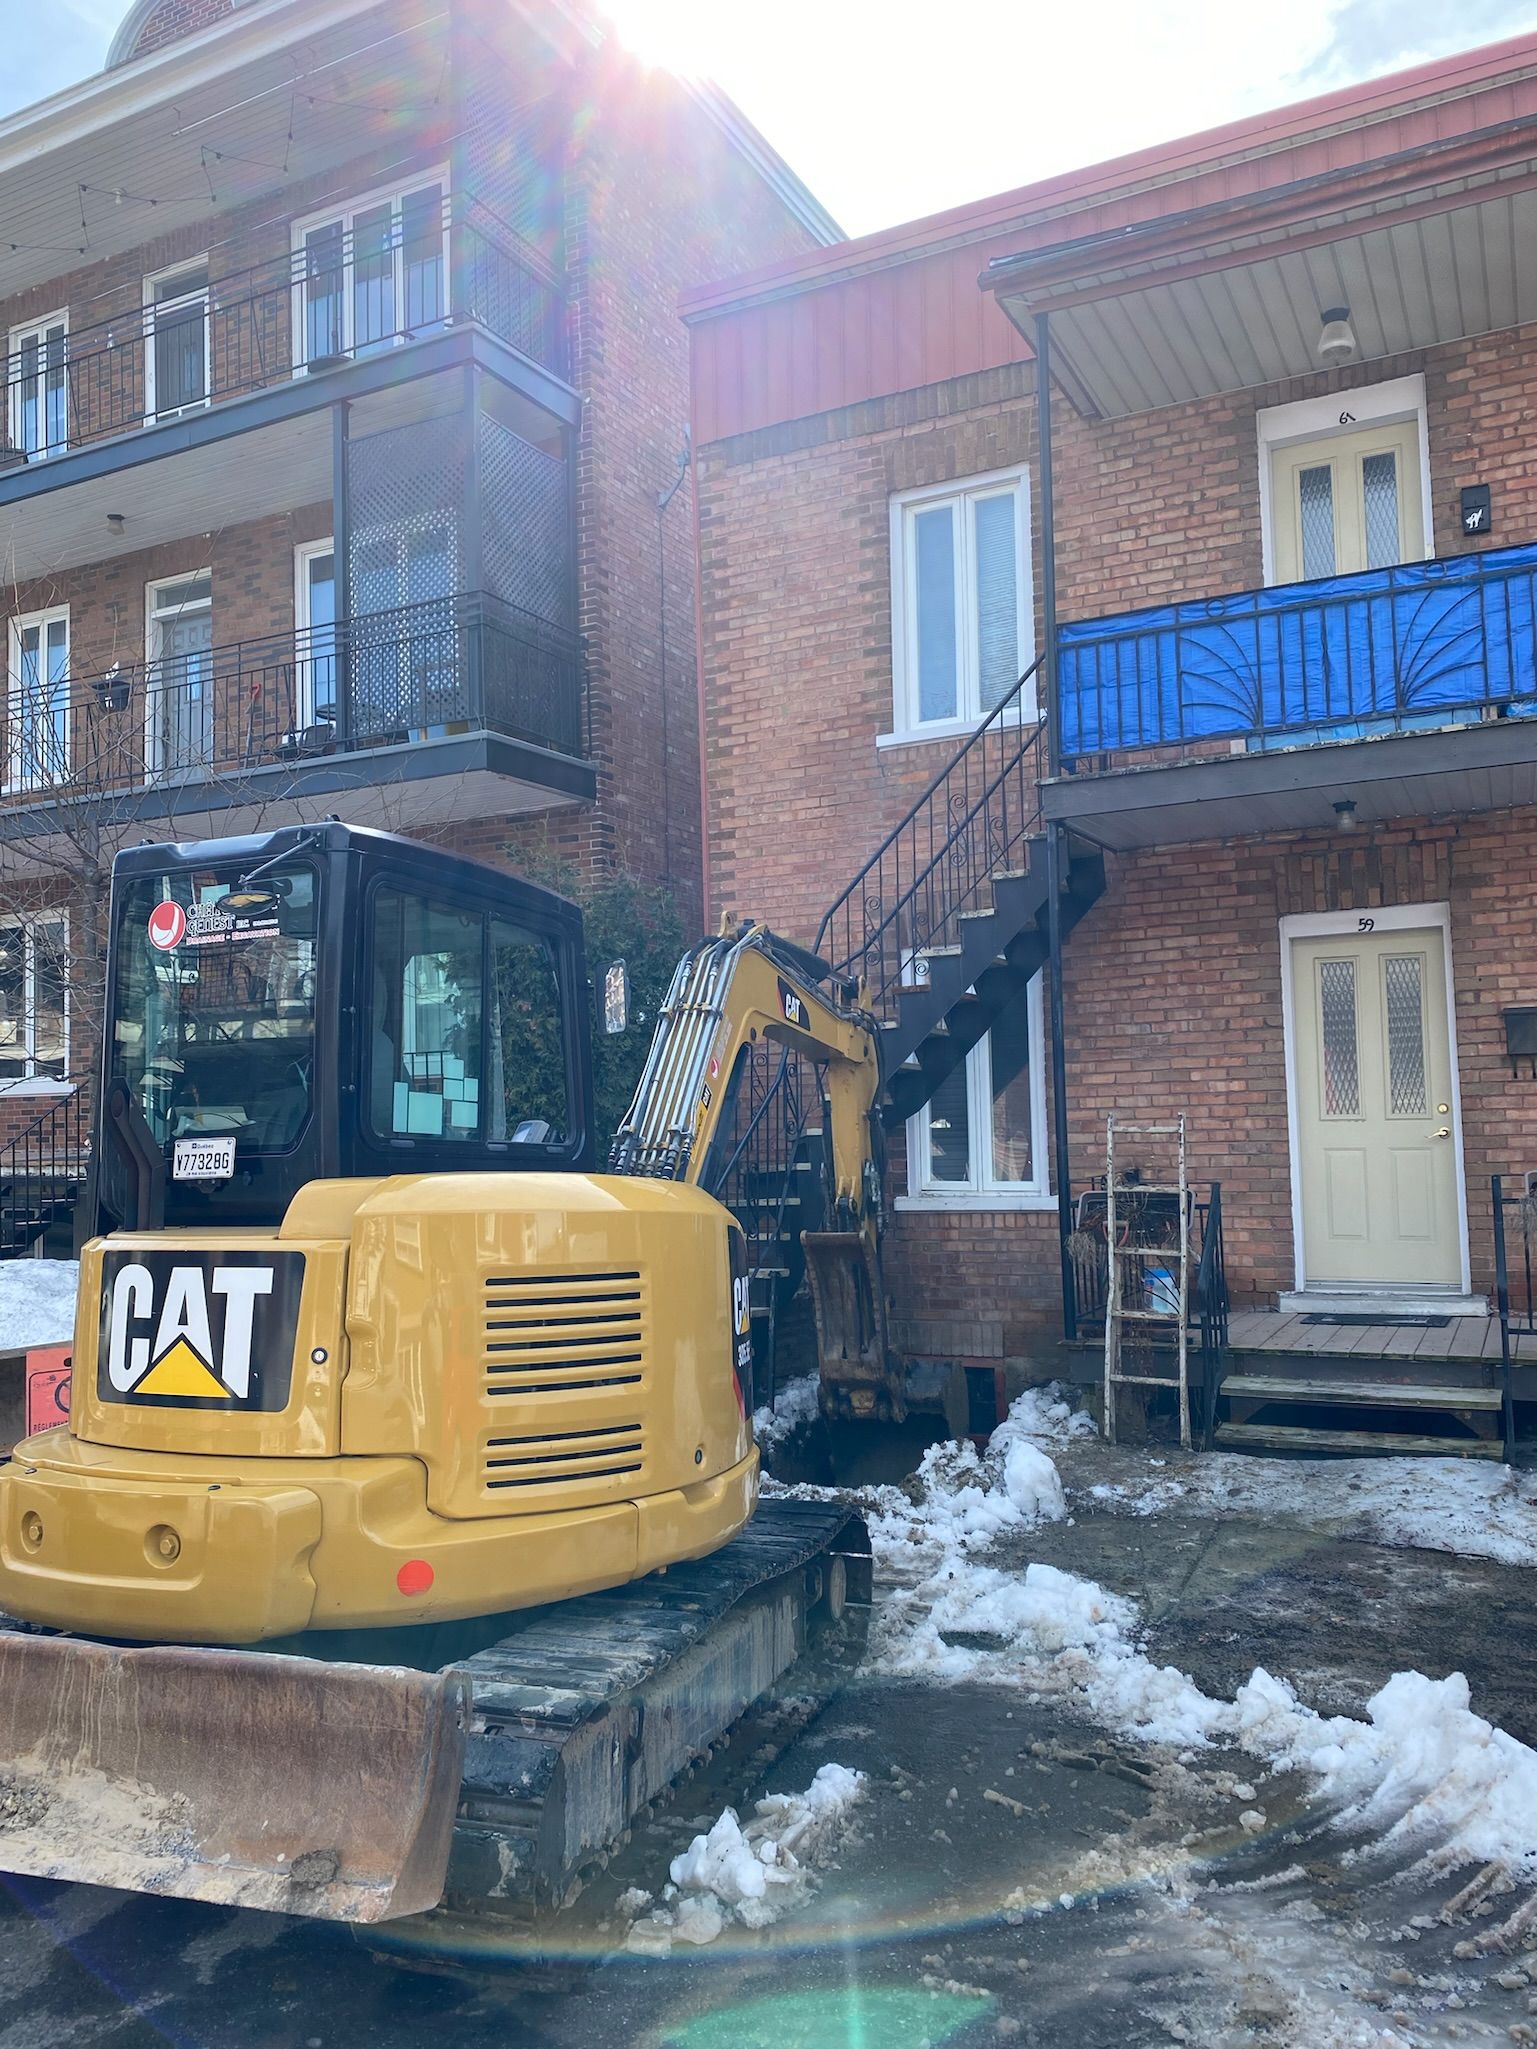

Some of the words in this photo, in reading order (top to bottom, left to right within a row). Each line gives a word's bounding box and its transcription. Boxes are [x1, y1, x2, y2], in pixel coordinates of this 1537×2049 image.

[186, 914, 235, 936] GENEST
[1358, 918, 1375, 931] 59
[785, 993, 800, 1023] CAT
[108, 1263, 274, 1399] CAT
